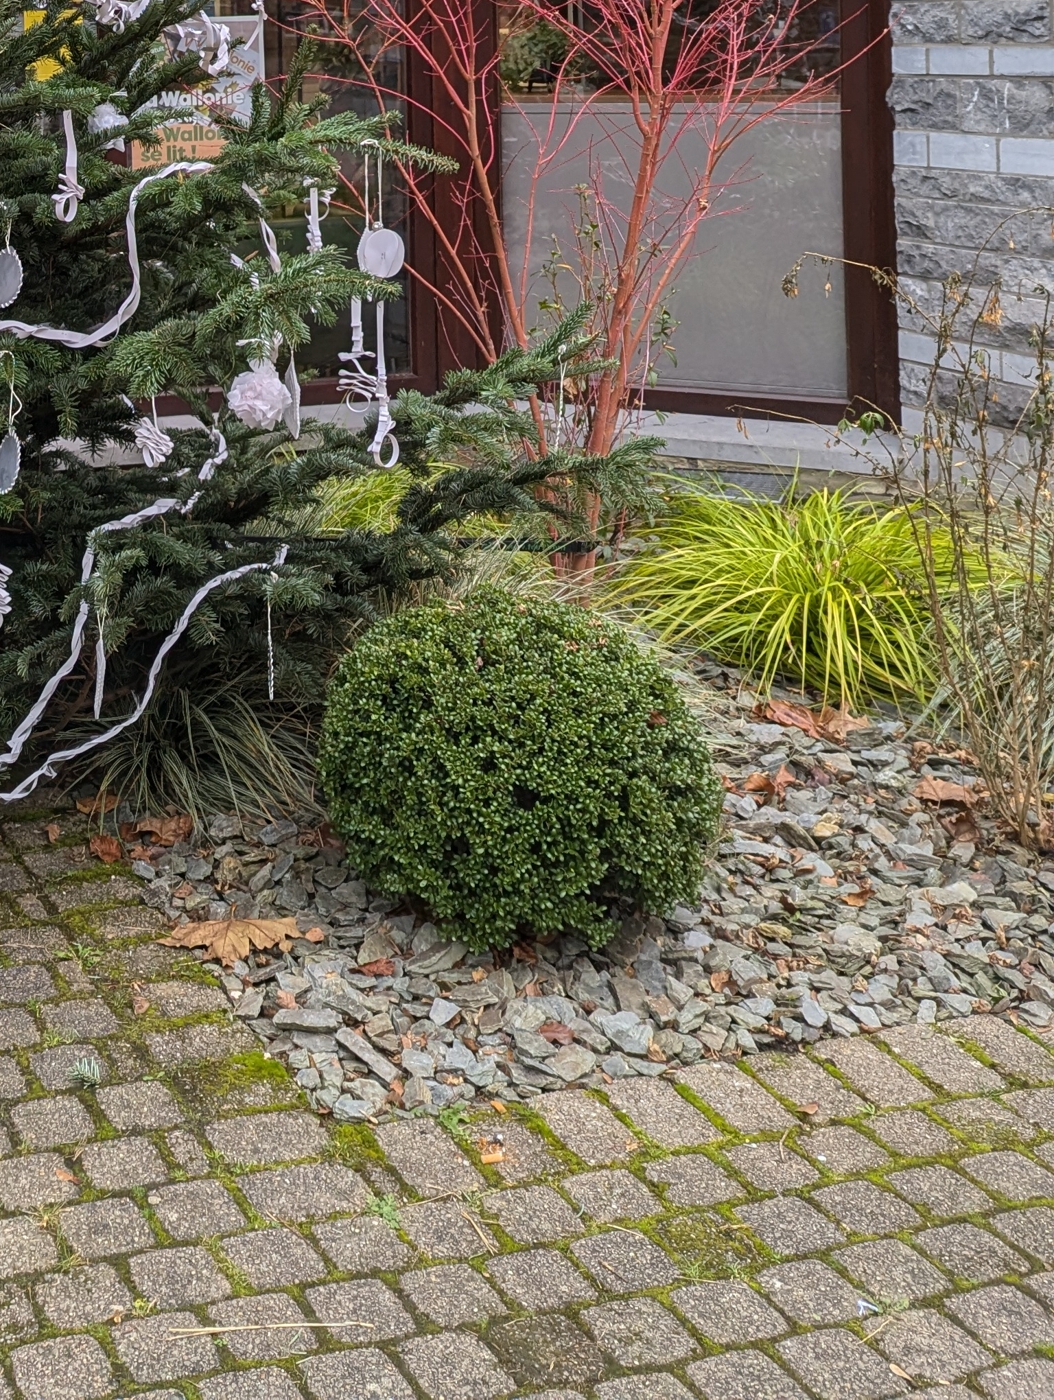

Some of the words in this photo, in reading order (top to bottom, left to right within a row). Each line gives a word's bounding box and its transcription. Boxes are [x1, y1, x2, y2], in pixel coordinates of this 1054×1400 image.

[229, 50, 256, 75] lonie
[160, 88, 245, 108] Wallonie
[162, 125, 223, 143] Wallo
[140, 150, 163, 162] se
